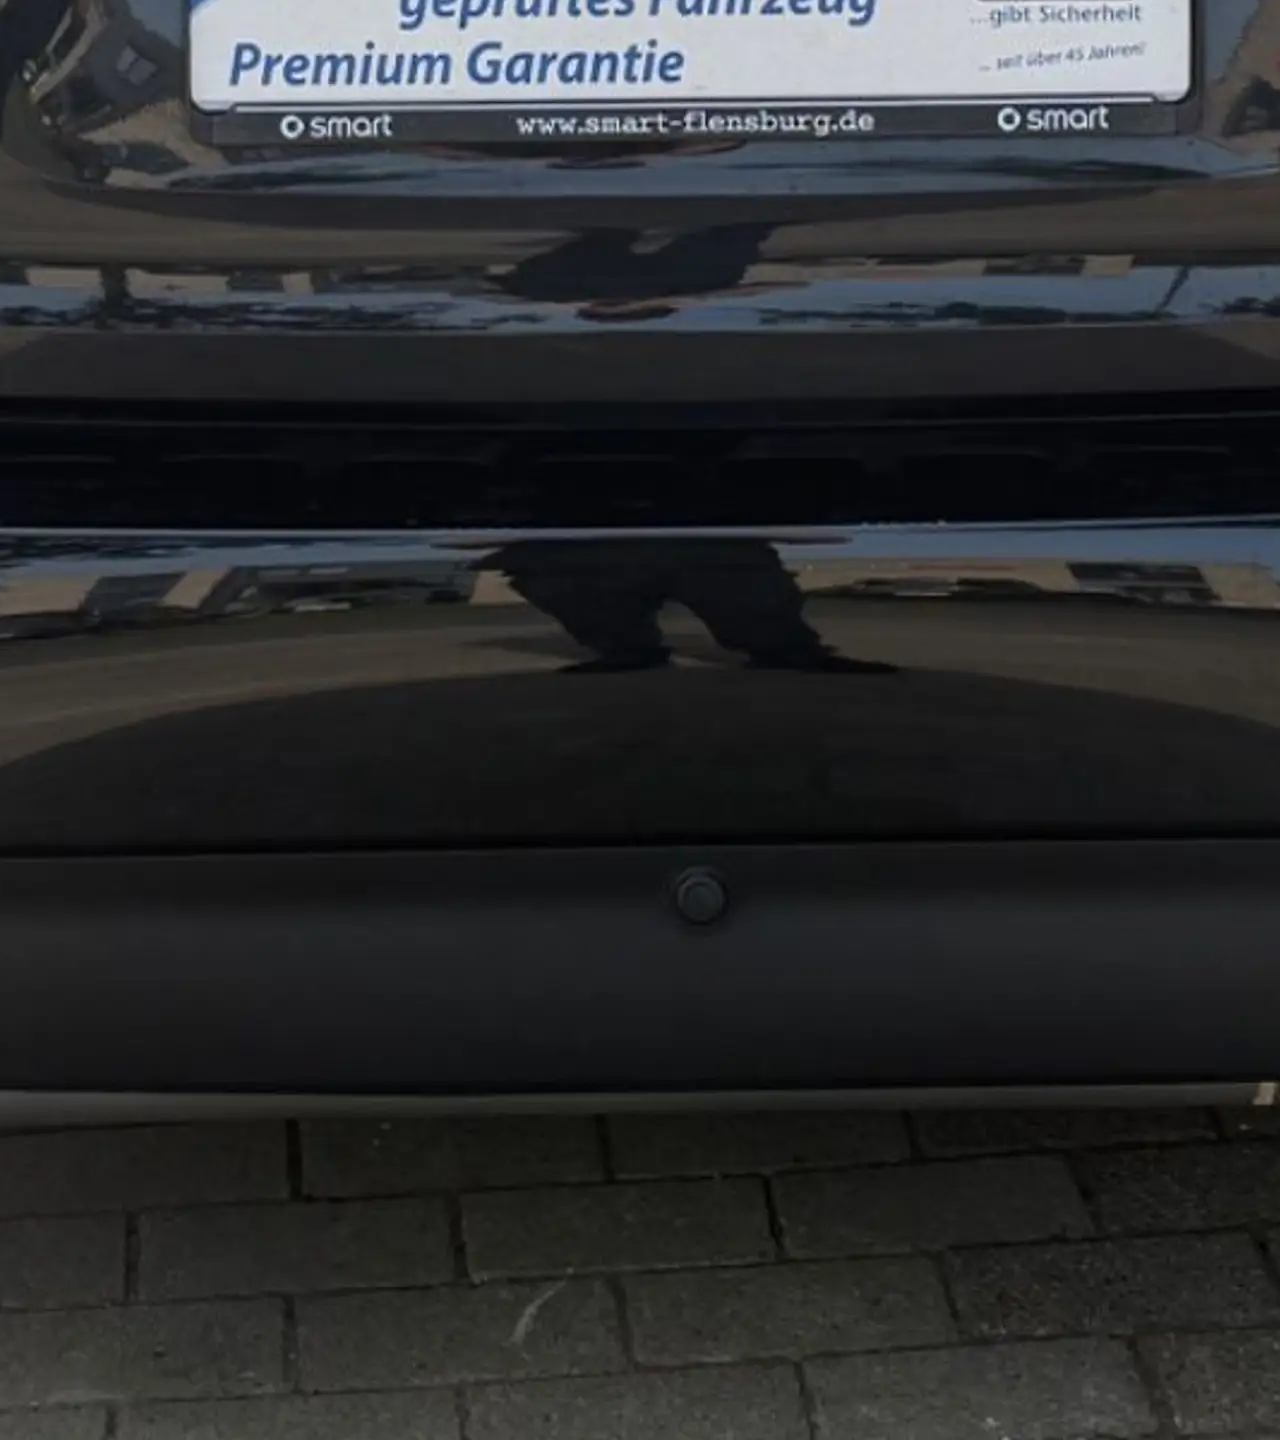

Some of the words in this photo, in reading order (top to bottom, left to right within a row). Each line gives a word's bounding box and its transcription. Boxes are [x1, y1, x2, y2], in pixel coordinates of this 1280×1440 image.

[1039, 5, 1142, 23] Sicherheit
[229, 42, 451, 86] Premium
[467, 40, 684, 85] Garantie
[310, 114, 393, 137] smart
[516, 112, 875, 137] www.smart-flensburg.de
[1026, 107, 1109, 130] smart
